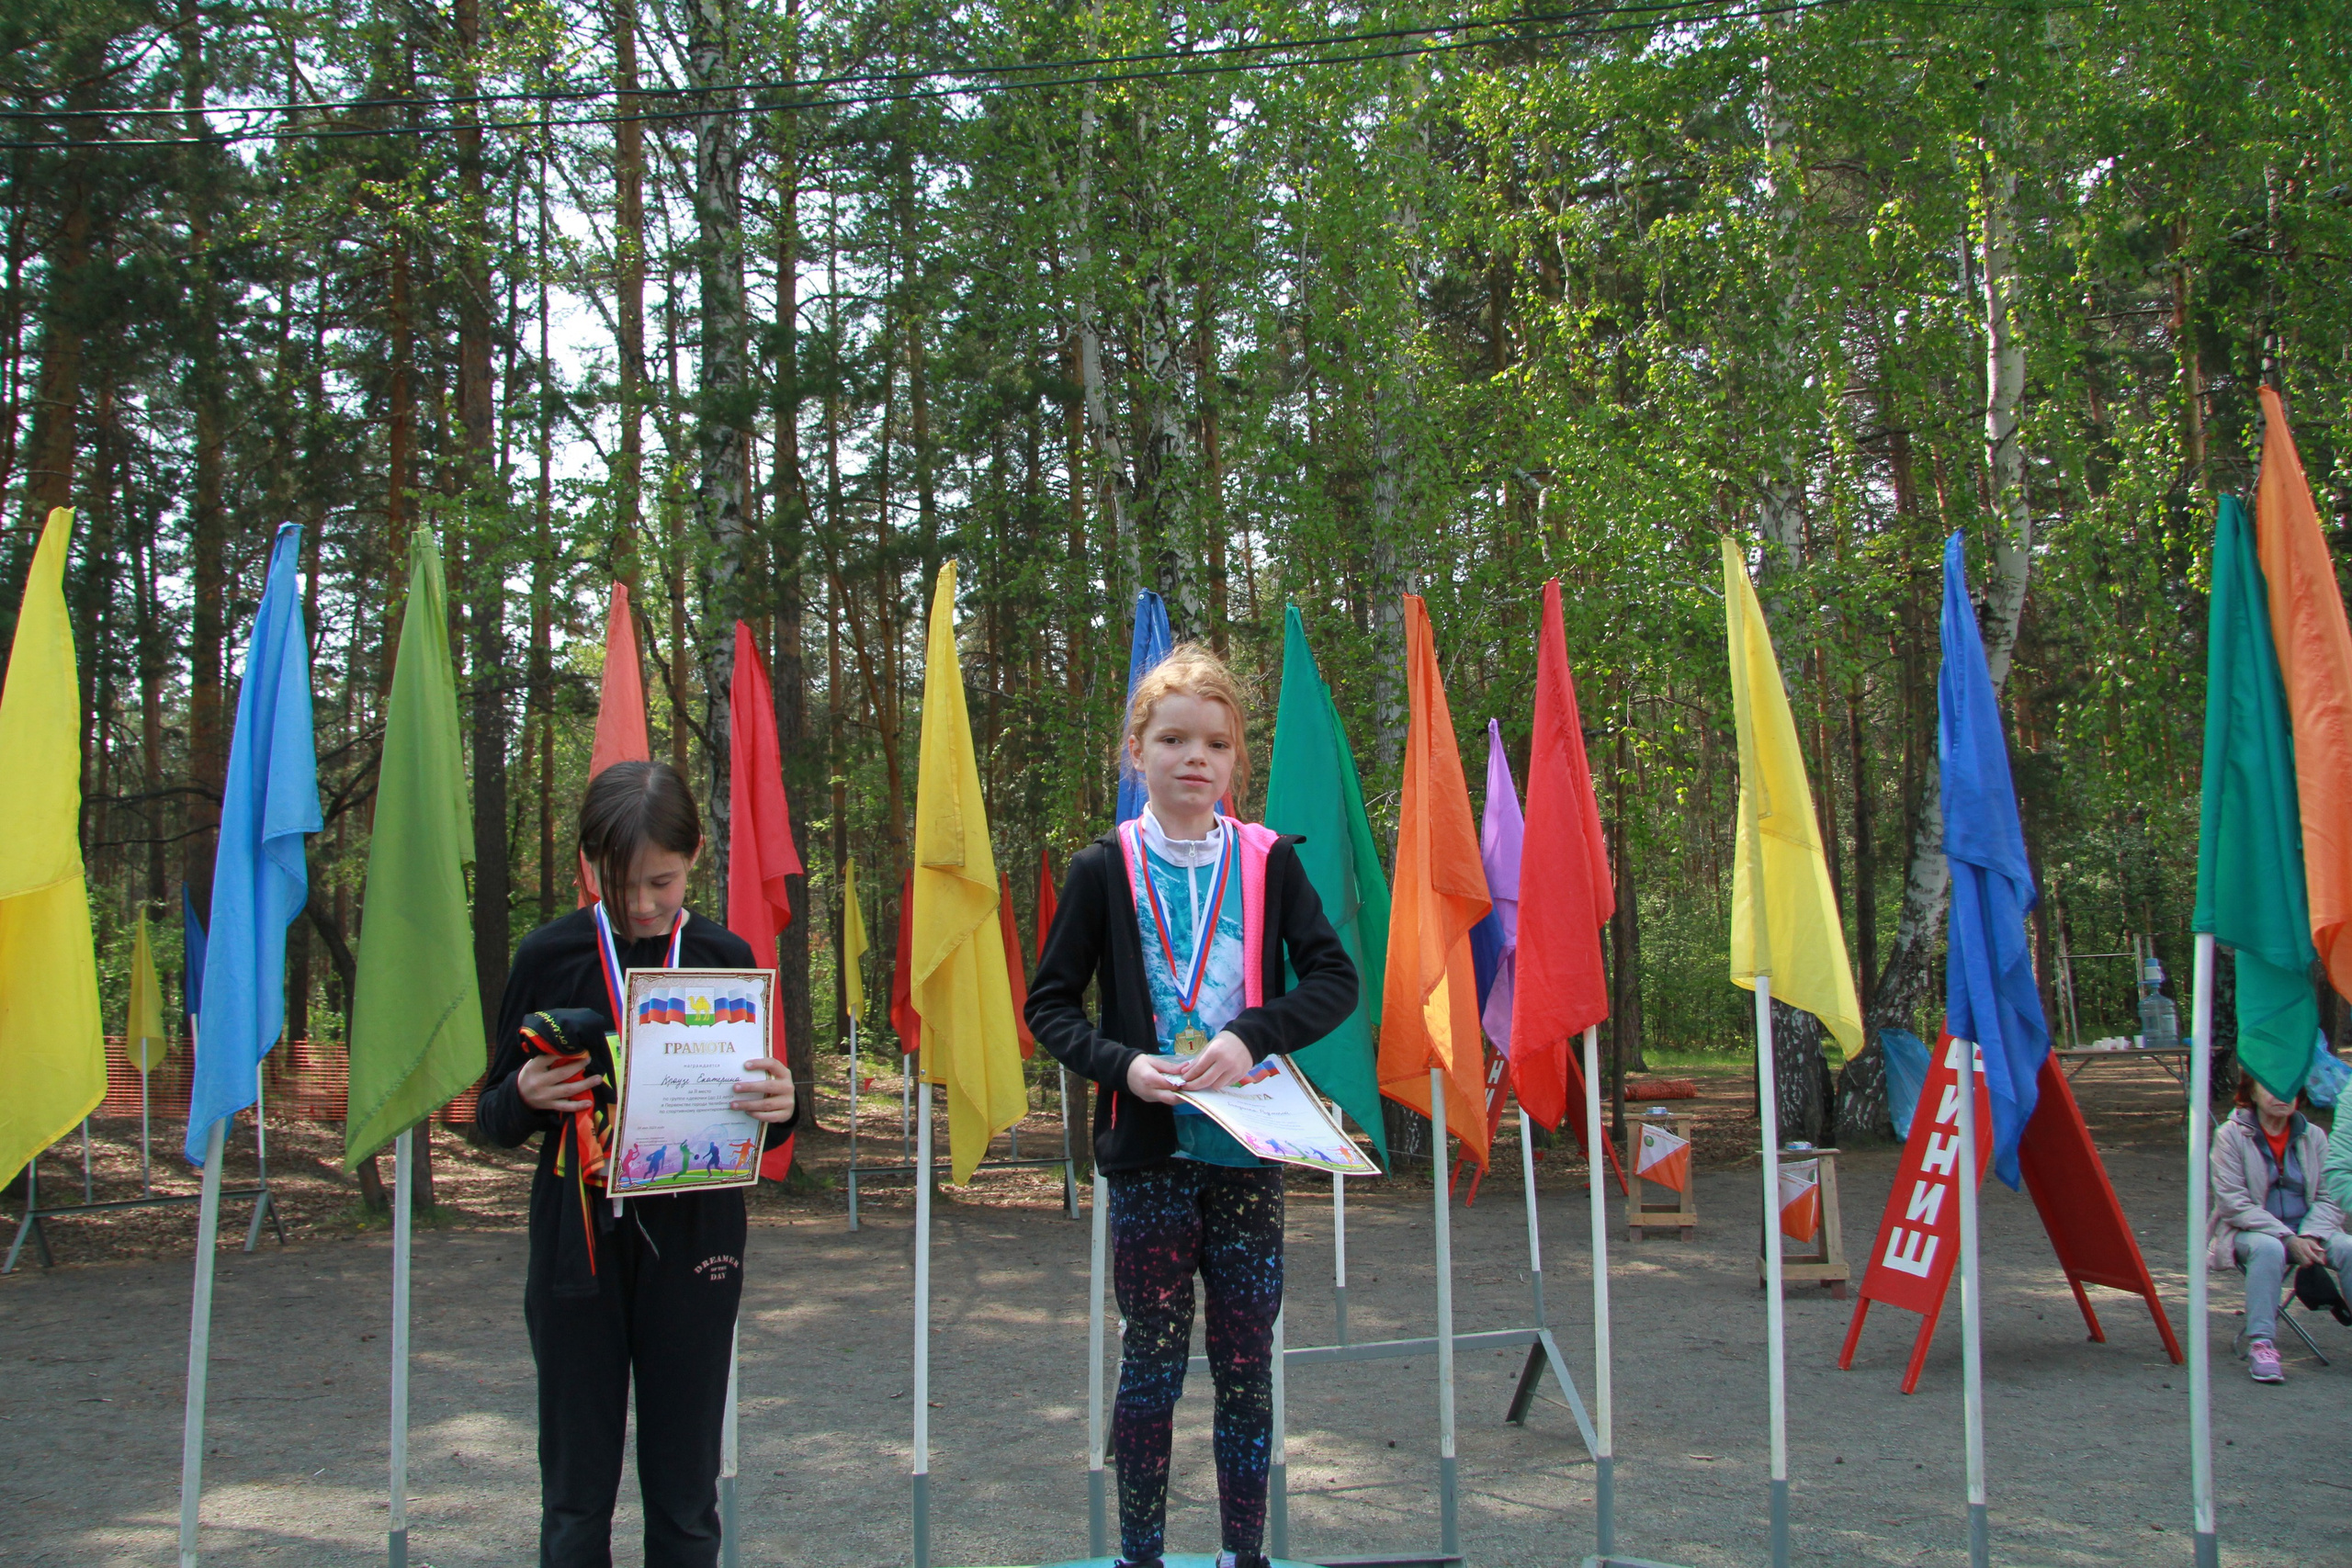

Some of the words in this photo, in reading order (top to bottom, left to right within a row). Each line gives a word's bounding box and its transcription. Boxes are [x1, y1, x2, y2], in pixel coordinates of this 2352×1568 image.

[664, 1041, 736, 1055] ГРАМОТА
[1188, 1041, 1194, 1051] 1
[694, 1254, 740, 1274] DREAMER
[710, 1272, 727, 1280] DAY
